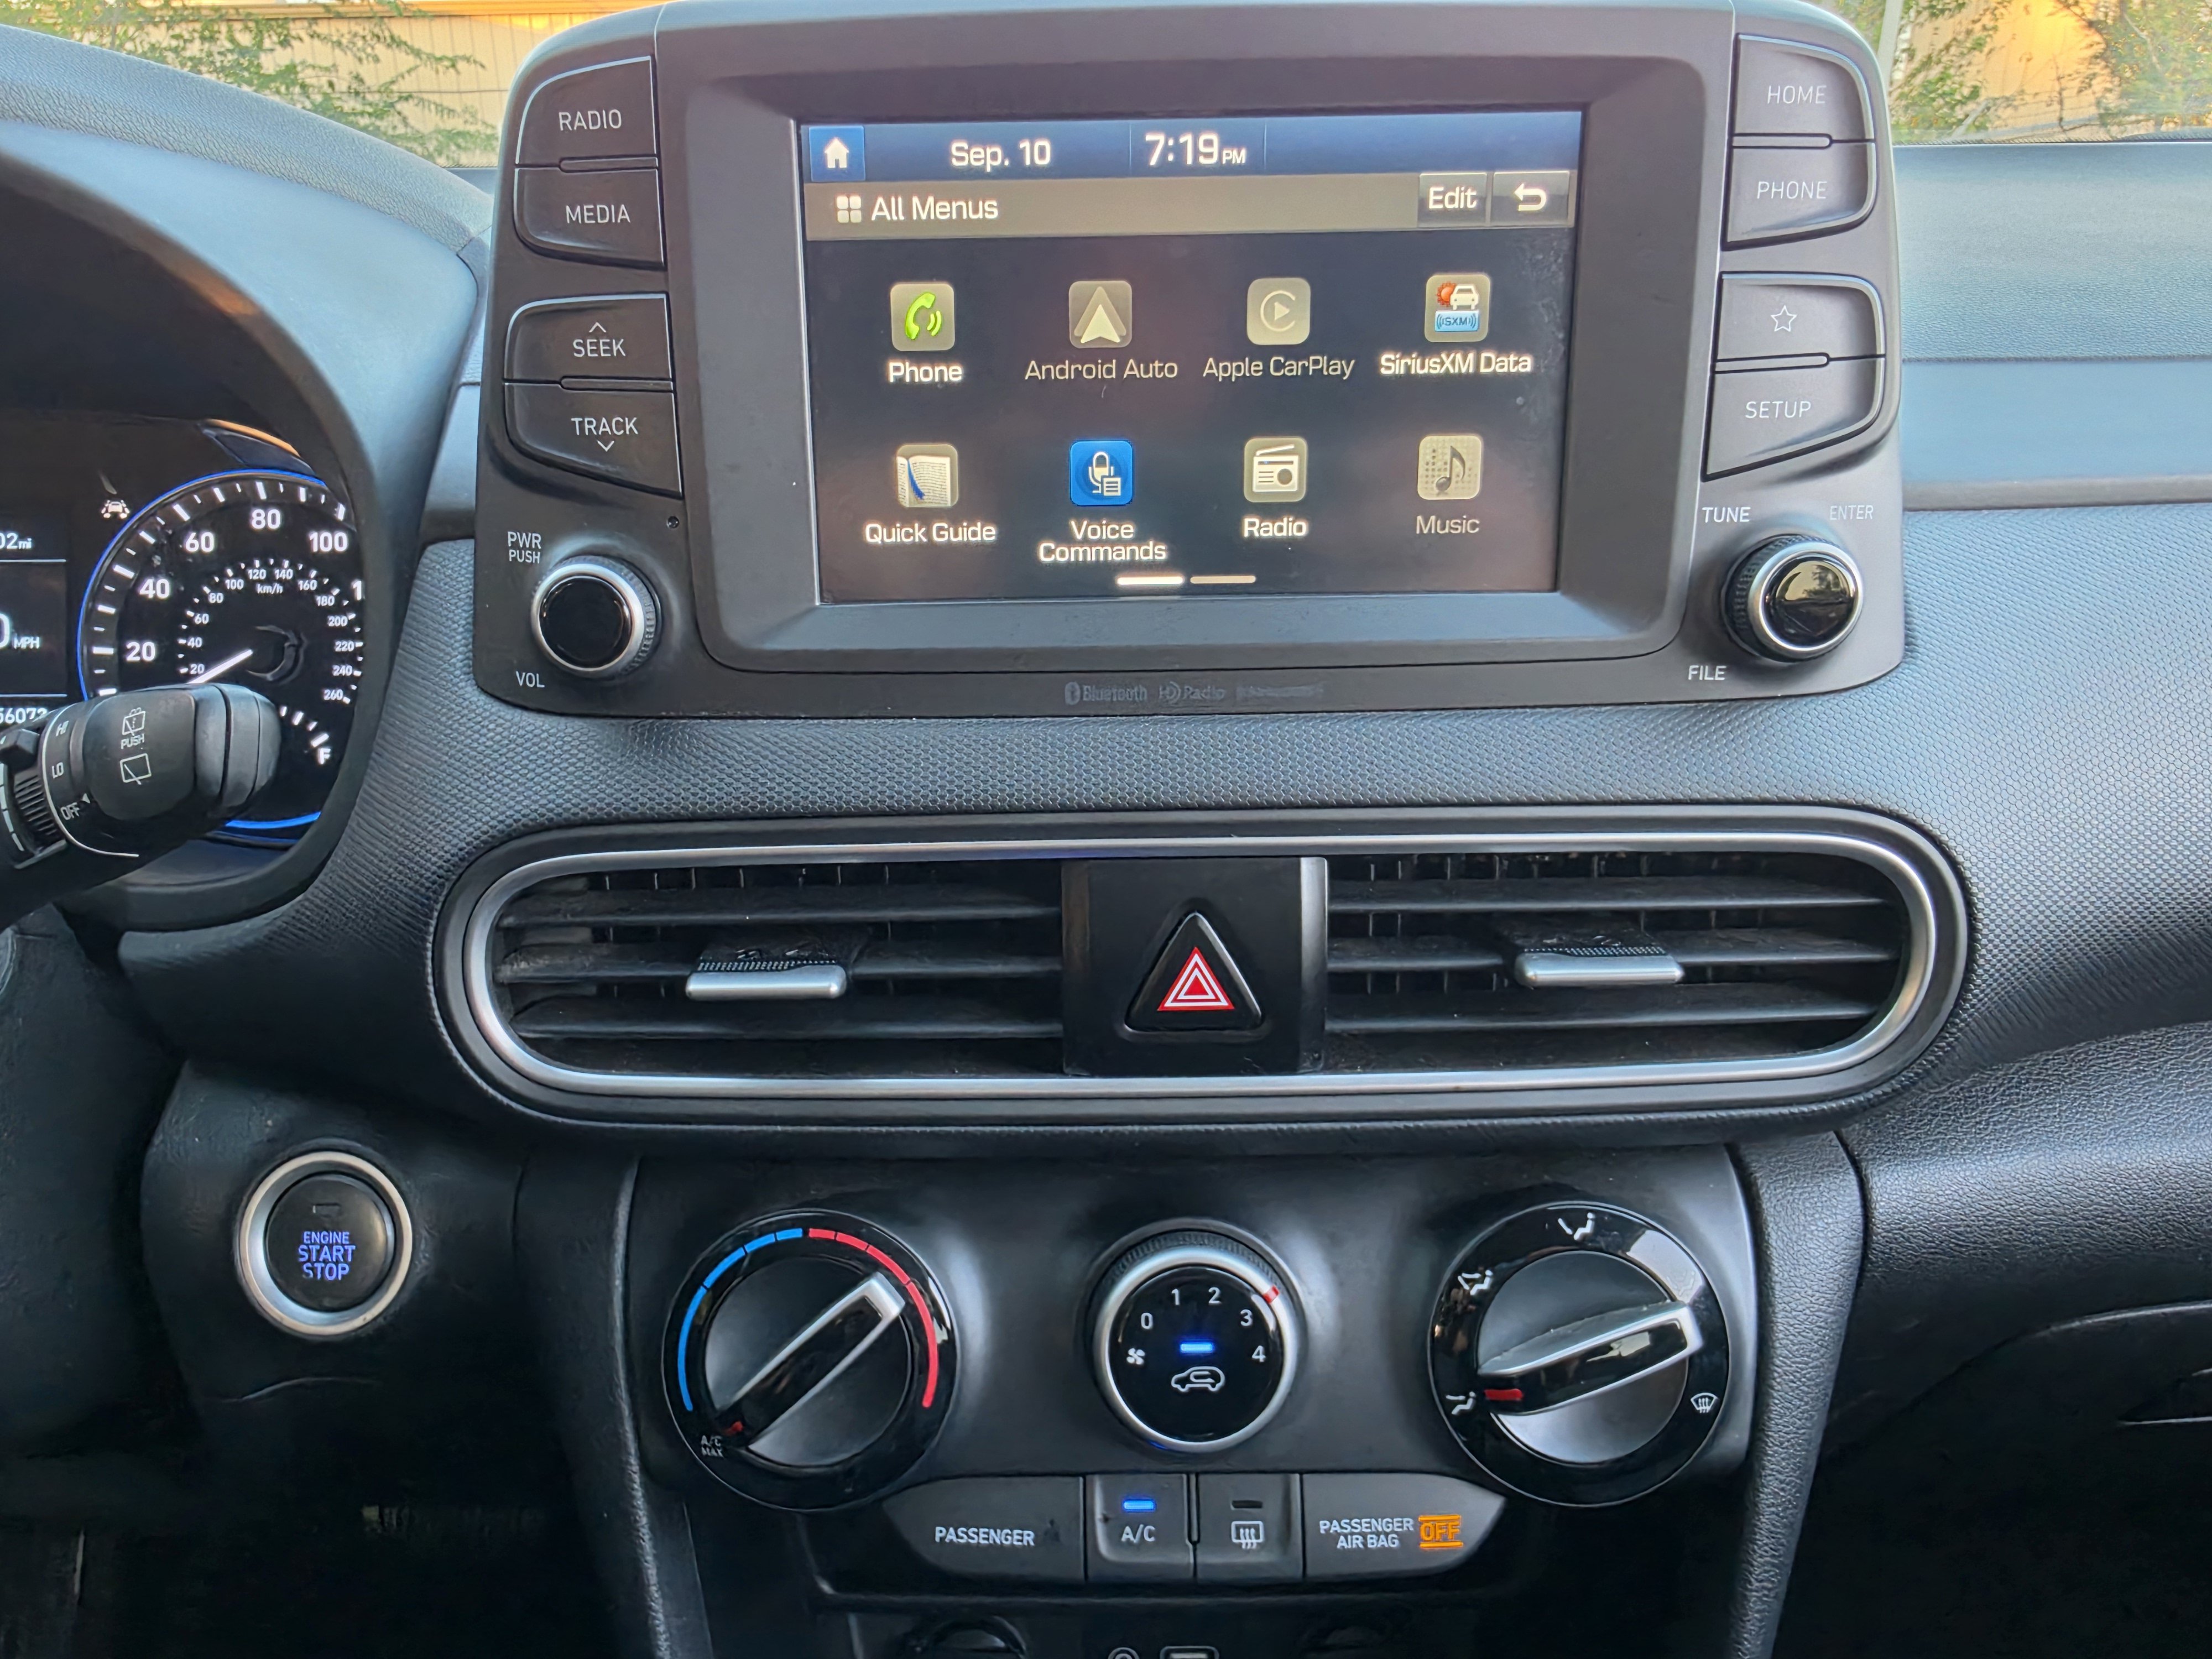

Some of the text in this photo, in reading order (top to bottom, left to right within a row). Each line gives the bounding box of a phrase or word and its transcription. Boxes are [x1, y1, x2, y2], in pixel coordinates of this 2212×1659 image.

[1767, 85, 1827, 104] HOME
[559, 109, 622, 131] RADIO
[950, 139, 1051, 171] Sep. 10
[1428, 186, 1477, 210] Edit
[1757, 181, 1828, 199] PHONE
[566, 204, 630, 223] MEDIA
[872, 196, 998, 220] All Menus
[1444, 317, 1468, 326] SXM
[573, 339, 625, 357] SEEK
[889, 361, 963, 383] Phone
[1025, 358, 1178, 380] Android Auto
[1203, 356, 1355, 382] Apple CarPlay
[1380, 352, 1532, 375] SiriusXM Data
[1745, 401, 1811, 419] SETUP
[571, 416, 638, 436] TRACK
[252, 508, 281, 529] 80
[1702, 507, 1751, 523] TUNE
[1829, 505, 1873, 520] ENTER
[865, 521, 996, 544] Quick Guide
[1070, 518, 1135, 540] Voice
[1243, 516, 1308, 538] Radio
[1416, 515, 1480, 534] Music
[185, 532, 214, 552] 60
[309, 531, 348, 552] 100
[508, 531, 542, 549] PWR
[509, 550, 541, 564] PUSH
[1039, 541, 1167, 562] Commands
[248, 568, 267, 580] 120
[274, 568, 293, 580] 140
[139, 578, 170, 598] 40
[225, 579, 244, 590] 100
[255, 582, 284, 594] km/h
[298, 580, 317, 591] 160
[208, 592, 224, 604] 80
[316, 596, 335, 607] 180
[194, 613, 209, 624] 60
[327, 615, 348, 627] 200
[13, 635, 40, 650] MPH
[126, 641, 156, 661] 20
[187, 637, 202, 648] 40
[335, 640, 354, 652] 220
[190, 664, 205, 675] 20
[332, 665, 353, 676] 240
[1688, 665, 1726, 681] FILE
[516, 671, 545, 688] VOL
[323, 689, 343, 701] 260
[56, 720, 69, 737] HI
[121, 733, 145, 750] PUSH
[317, 748, 331, 765] F
[51, 761, 65, 779] LO
[60, 802, 80, 821] OFF
[304, 1230, 349, 1245] ENGINE
[298, 1244, 356, 1262] START
[302, 1262, 349, 1281] STOP
[1171, 1288, 1181, 1306] 1
[1208, 1287, 1222, 1305] 2
[1141, 1312, 1154, 1329] 0
[1240, 1308, 1253, 1327] 3
[1251, 1345, 1266, 1363] 4
[935, 1526, 1035, 1546] PASSENGER
[1121, 1524, 1156, 1543] A/C
[1319, 1517, 1460, 1542] PASSENGER OFF
[1337, 1534, 1400, 1549] AIR BAG
